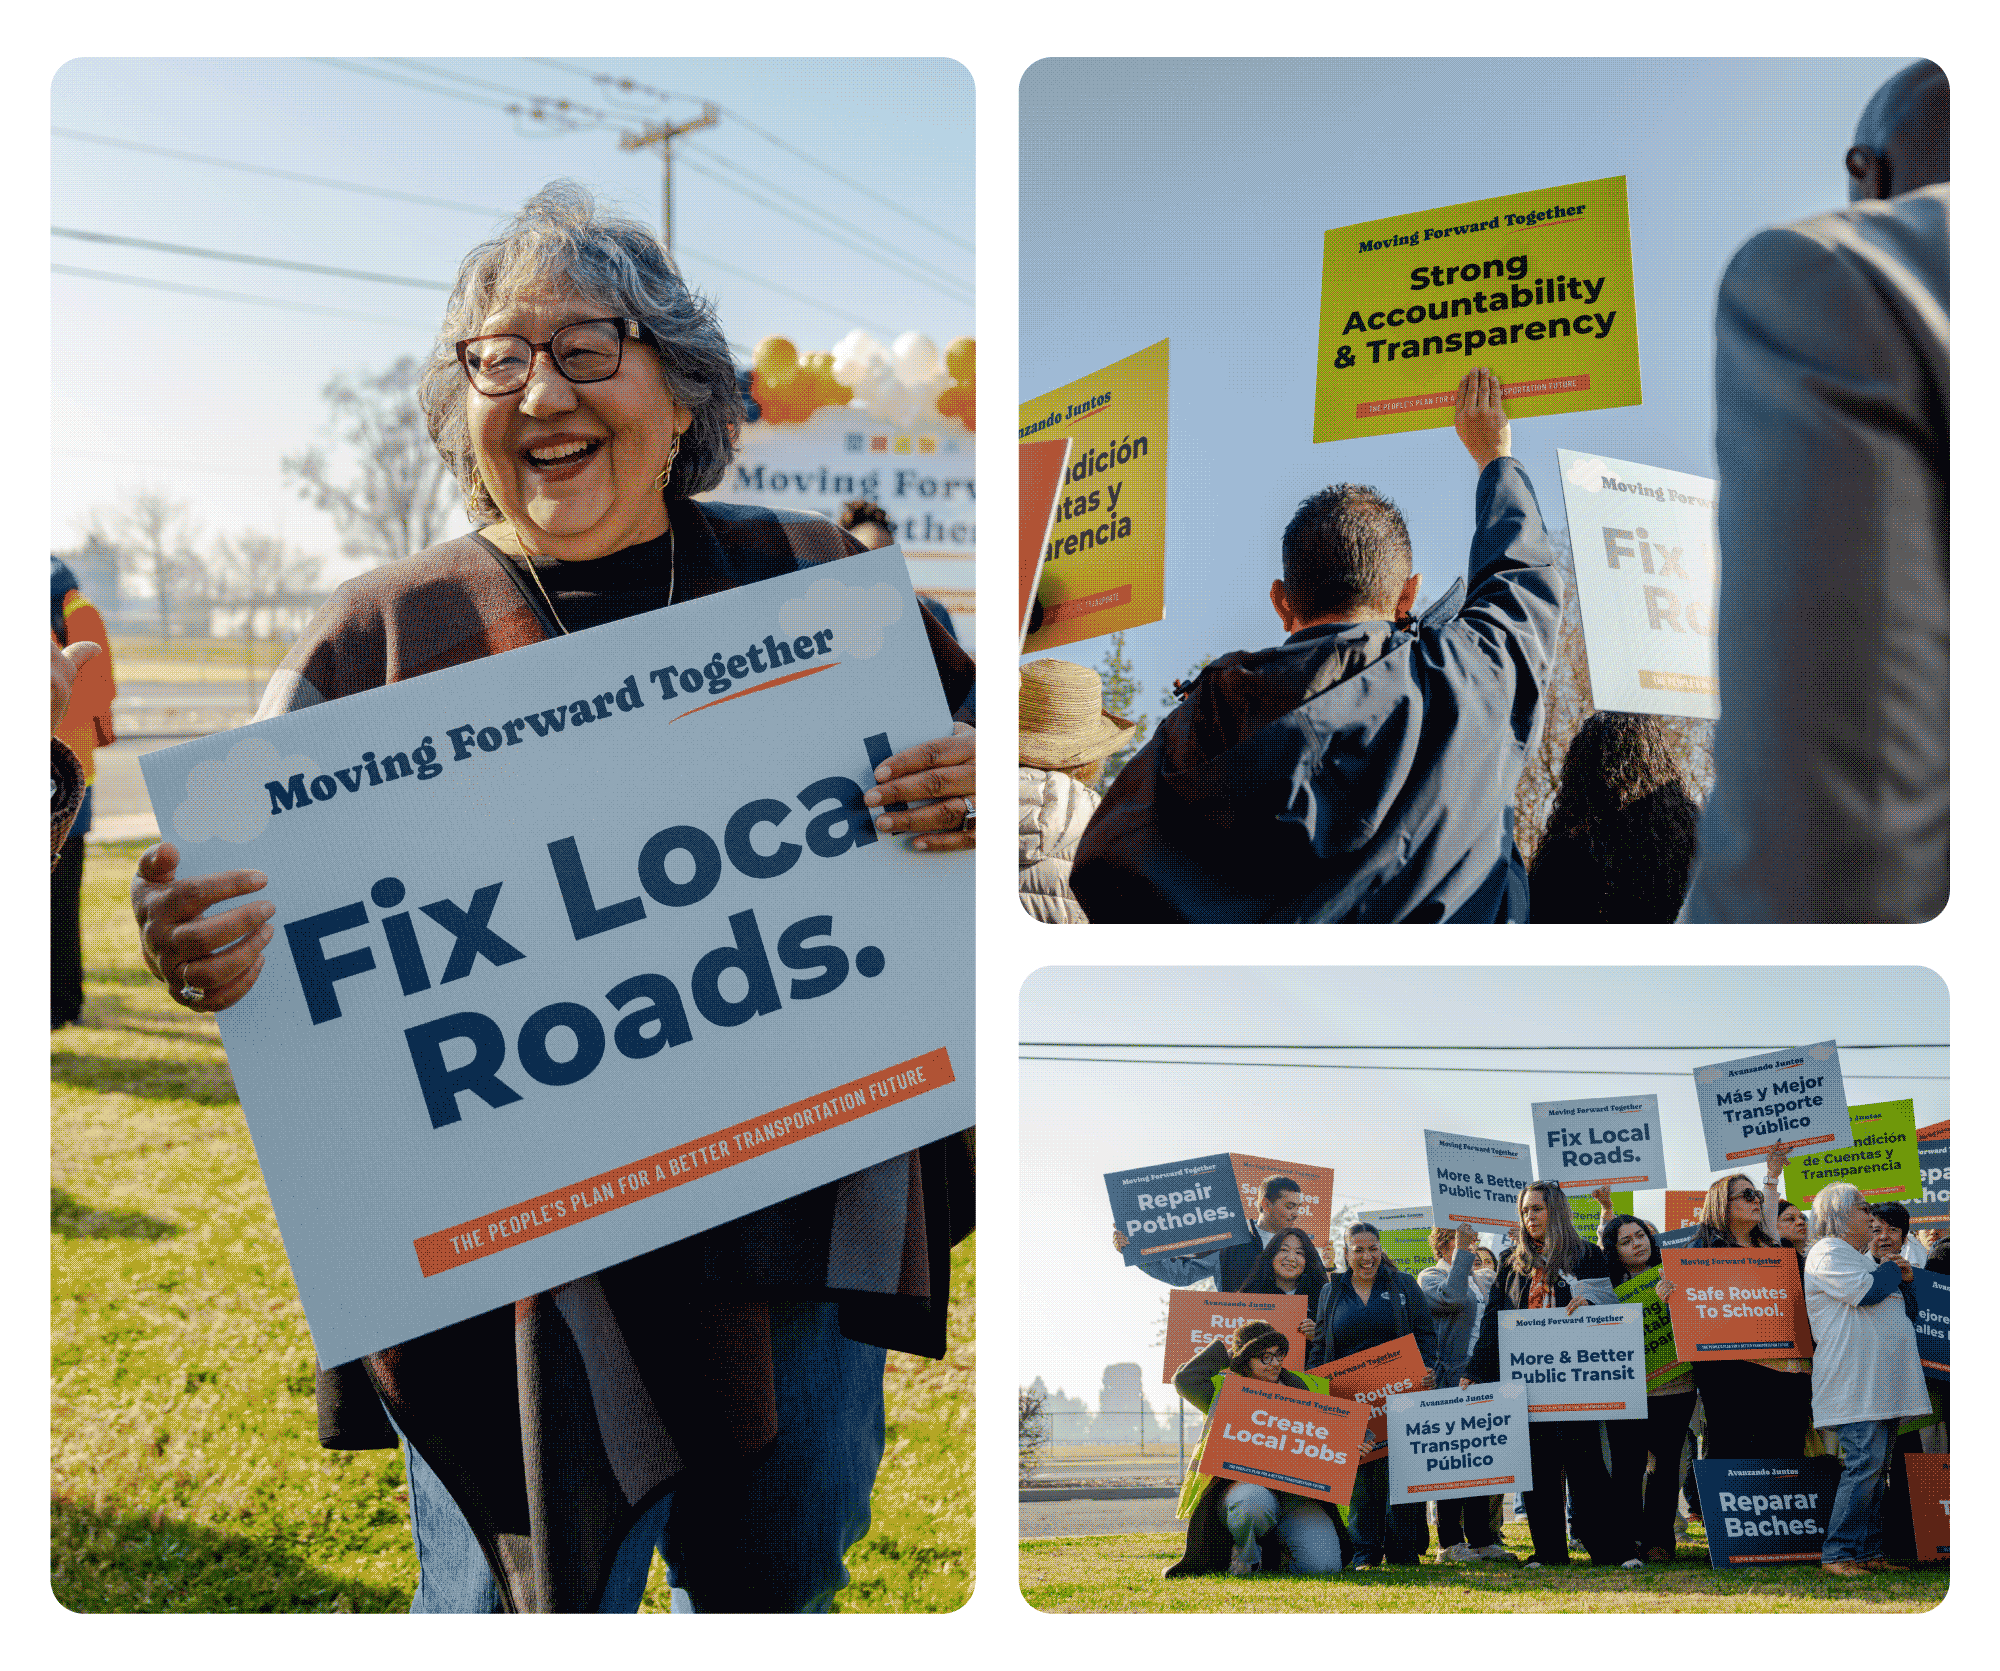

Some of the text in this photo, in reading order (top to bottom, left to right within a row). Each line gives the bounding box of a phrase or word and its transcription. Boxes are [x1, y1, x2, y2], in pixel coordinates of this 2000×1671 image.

[1359, 204, 1586, 253] Moving Forward Together
[1410, 254, 1529, 291] Strong
[1342, 276, 1606, 335] Accountability
[1333, 310, 1617, 369] & Transparency
[1065, 391, 1111, 420] Juntos
[733, 464, 880, 502] Moving
[1601, 476, 1665, 502] Moving
[1107, 481, 1123, 512] y
[1602, 526, 1690, 580] Fix
[264, 627, 834, 815] Moving Forward Together
[283, 876, 527, 1026] Fix
[404, 907, 887, 1131] Roads.
[1728, 1057, 1804, 1077] Avanzando Juntos
[1716, 1074, 1824, 1107] Más y Mejor
[1548, 1103, 1643, 1116] Moving Forward Together
[1723, 1093, 1823, 1122] Transporte
[1547, 1123, 1651, 1148] Fix Local
[1742, 1116, 1811, 1138] Público
[450, 1065, 928, 1256] THE PEOPLE'S PLAN FOR A BETTER TRANSPORTATION FUTURE
[1562, 1146, 1641, 1168] Roads.
[1803, 1148, 1894, 1167] de Cuentas y
[1122, 1164, 1216, 1186] Moving Forward Together
[1436, 1167, 1527, 1190] More & Better
[1801, 1160, 1902, 1181] Transparencia
[1137, 1182, 1212, 1211] Repair
[1438, 1183, 1481, 1201] Public
[1126, 1206, 1236, 1237] Potholes.
[1680, 1256, 1782, 1267] Moving Forward Together
[1686, 1286, 1788, 1302] Safe Routes
[1211, 1314, 1267, 1328] Rut
[1516, 1314, 1623, 1327] Moving Forward Together
[1695, 1303, 1784, 1319] To School.
[1510, 1348, 1634, 1366] More & Better
[1512, 1368, 1566, 1384] Public
[1571, 1364, 1635, 1381] Transit
[1241, 1386, 1350, 1416] Moving Forward Together
[1354, 1378, 1413, 1404] Routes
[1420, 1393, 1494, 1408] Avanzando Juntos
[1251, 1410, 1329, 1440] Create
[1405, 1413, 1511, 1437] Más y Mejor
[1222, 1423, 1347, 1465] Local Jobs
[1410, 1432, 1508, 1454] Transporte
[1426, 1452, 1494, 1472] Público
[1727, 1468, 1798, 1477] Avanzando Juntos
[1719, 1492, 1818, 1515] Reparar
[1724, 1515, 1825, 1538] Baches.
